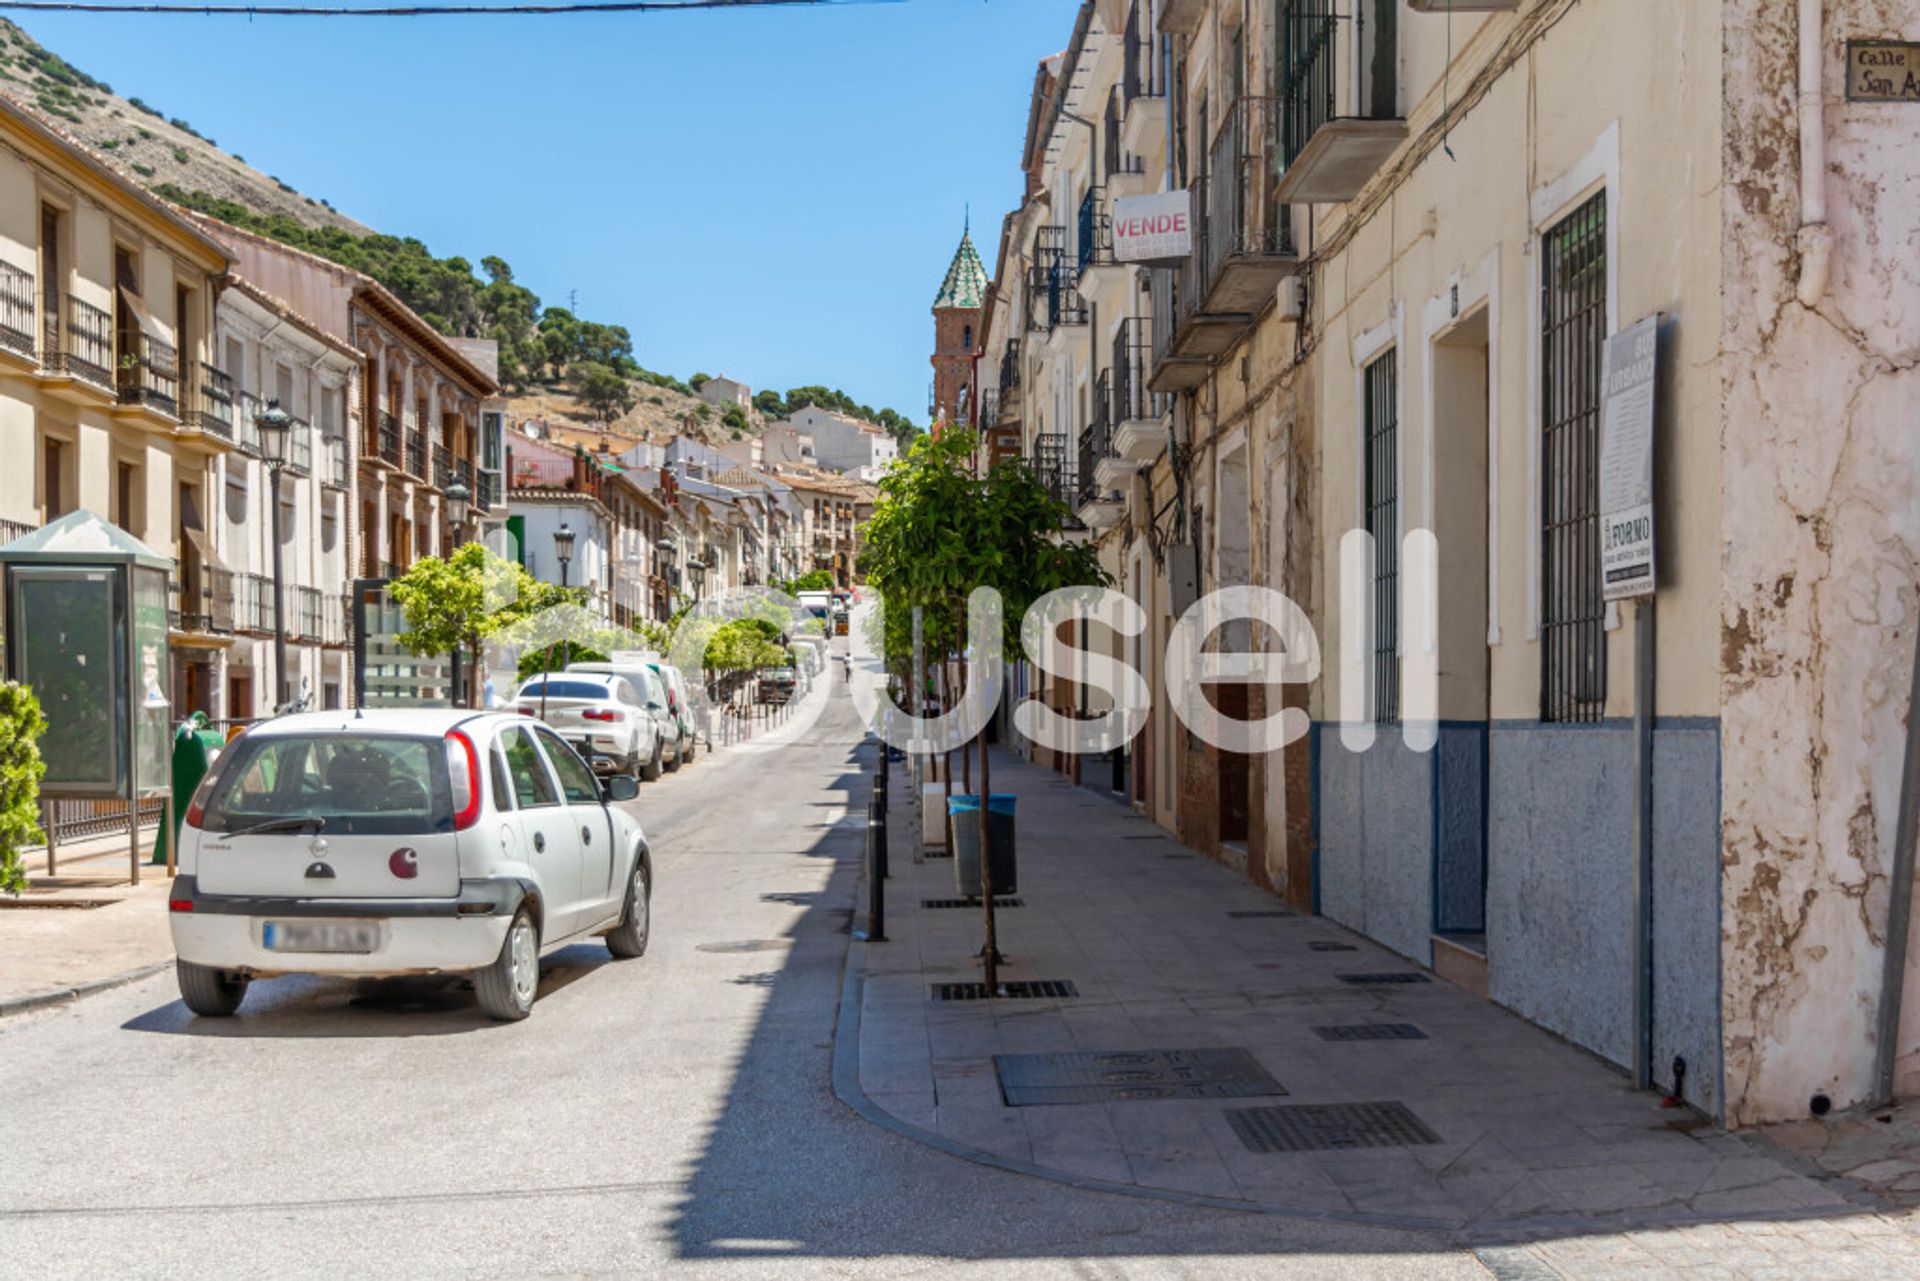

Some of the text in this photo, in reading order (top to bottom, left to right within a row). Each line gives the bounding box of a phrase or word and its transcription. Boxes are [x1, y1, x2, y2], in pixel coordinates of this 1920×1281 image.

[1858, 50, 1905, 66] Calle
[1858, 69, 1896, 96] San
[1115, 212, 1187, 238] VENDE
[1612, 516, 1650, 548] FORNO
